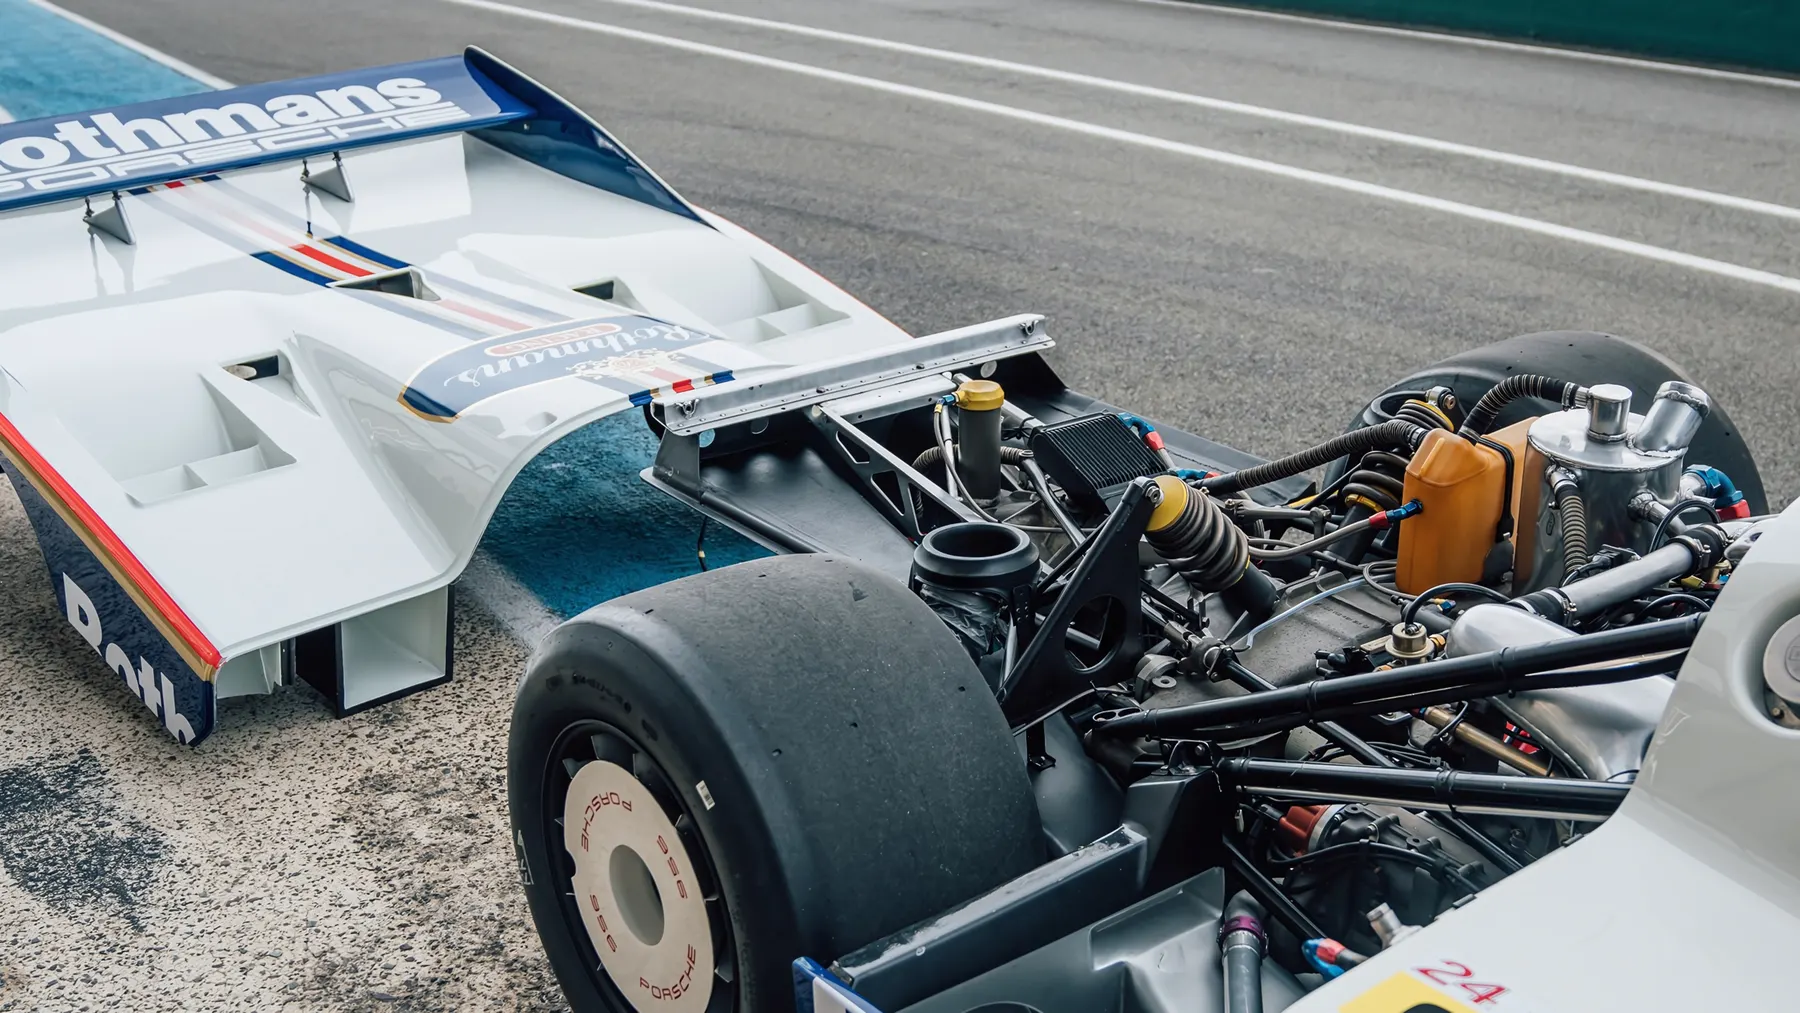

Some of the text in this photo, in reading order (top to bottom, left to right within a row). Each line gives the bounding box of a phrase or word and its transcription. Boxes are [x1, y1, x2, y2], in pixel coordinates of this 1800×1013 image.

[0, 77, 442, 174] othmans
[444, 325, 710, 388] Rothmans
[581, 791, 633, 852] PORSCHE
[656, 834, 688, 900] 956
[589, 894, 618, 953] 956
[639, 943, 697, 1001] PORSCHE
[1412, 958, 1510, 1005] 24
